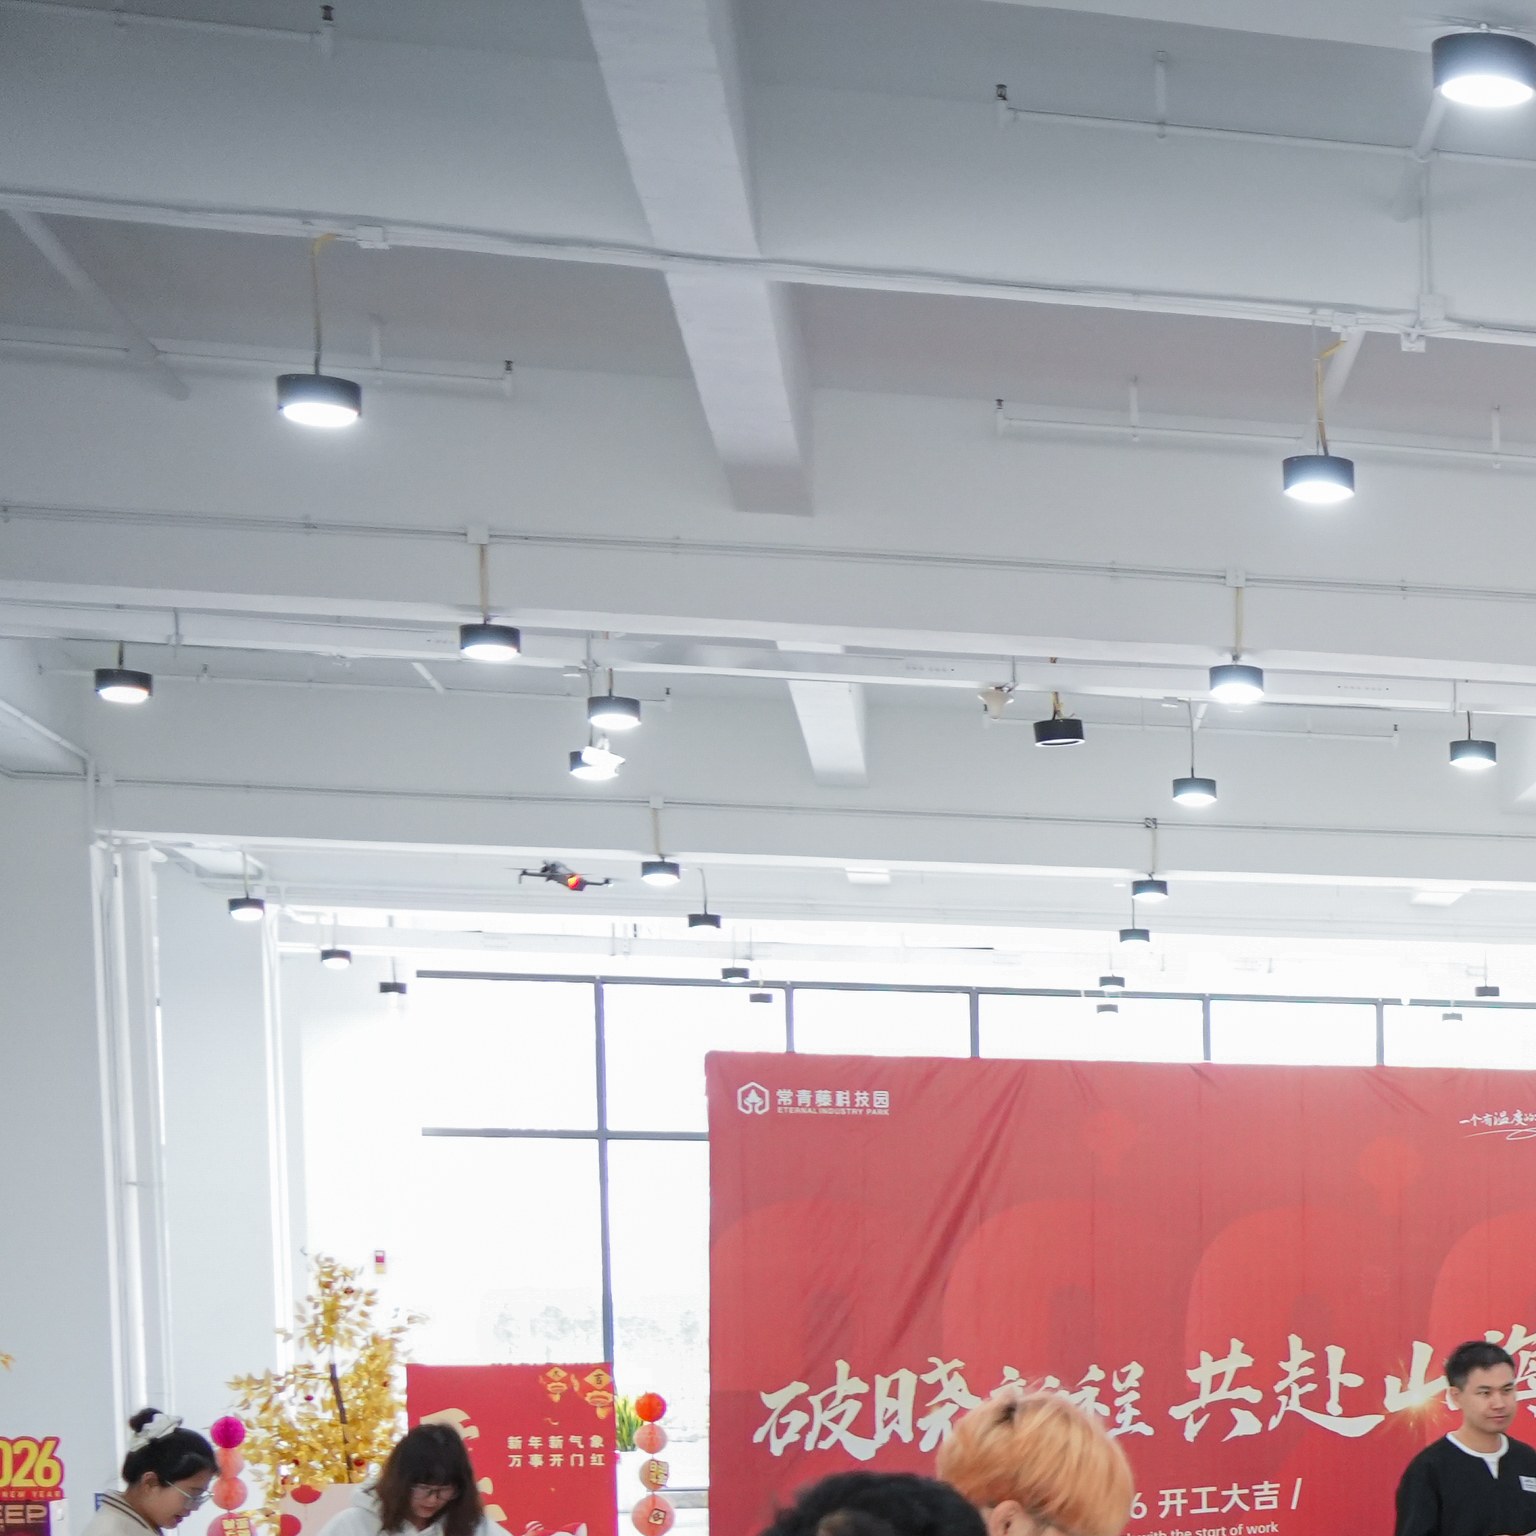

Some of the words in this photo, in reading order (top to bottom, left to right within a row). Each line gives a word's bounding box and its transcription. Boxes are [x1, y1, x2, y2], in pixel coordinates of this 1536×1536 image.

[776, 1088, 890, 1108] 常青藤科技园
[777, 1107, 818, 1115] ETERNAL
[819, 1108, 863, 1116] INDUSTRY
[507, 1435, 604, 1449] 新年新气象
[508, 1453, 605, 1468] 万事开门红
[1158, 1480, 1281, 1518] 开工大吉
[1230, 1523, 1244, 1536] of
[1246, 1521, 1279, 1535] work
